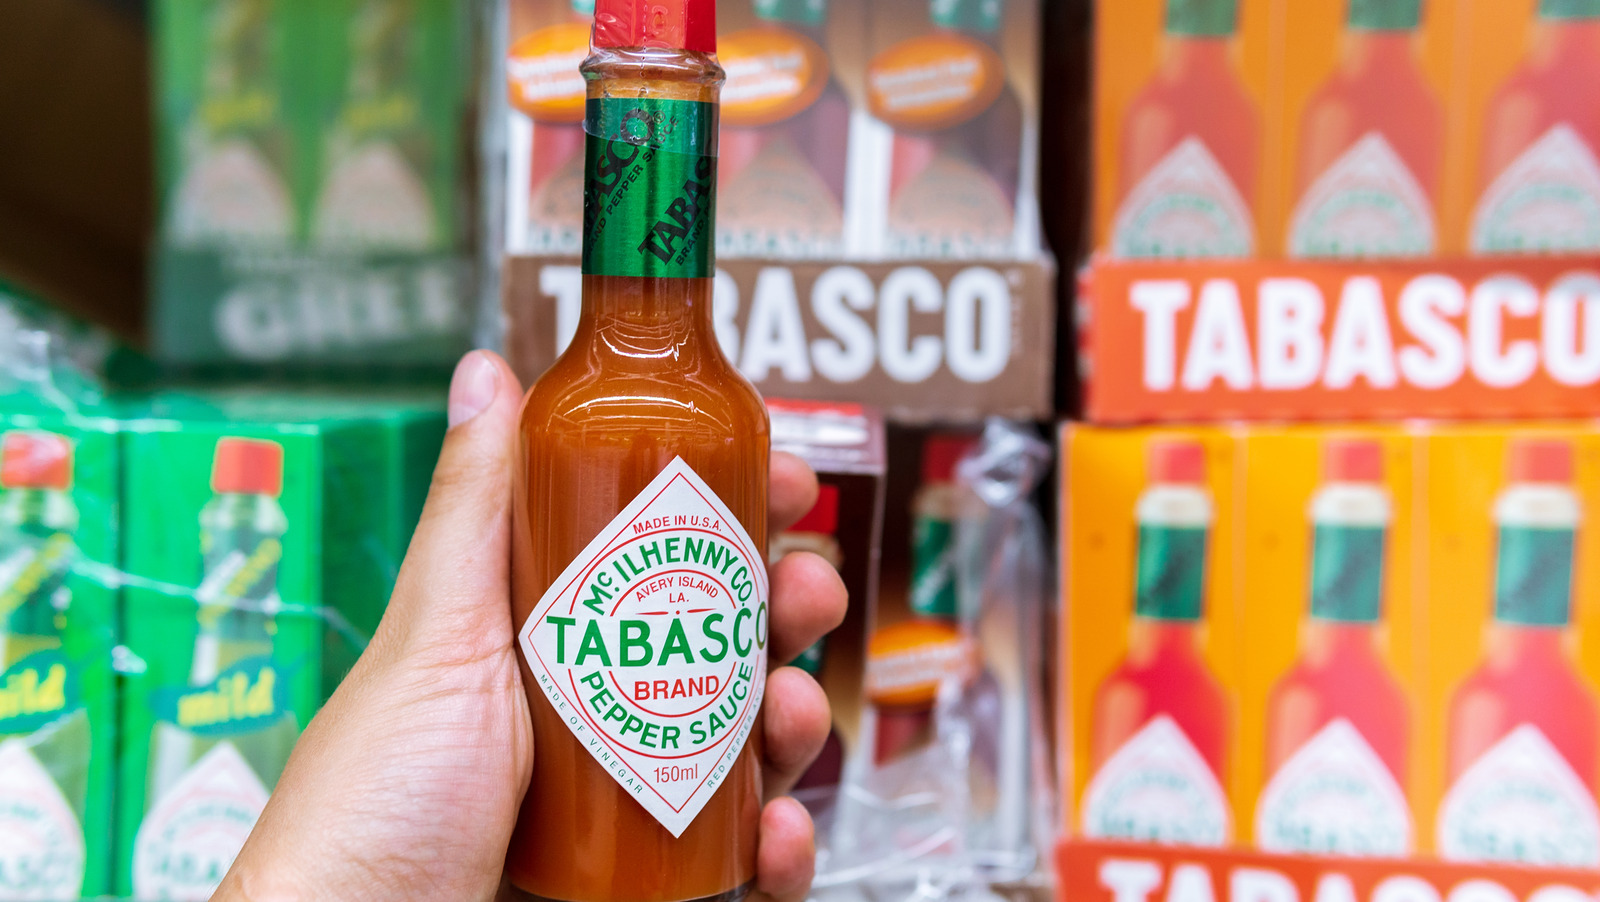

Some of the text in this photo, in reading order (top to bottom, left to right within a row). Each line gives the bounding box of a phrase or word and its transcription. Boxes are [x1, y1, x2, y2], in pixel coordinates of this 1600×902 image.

[606, 163, 643, 215] PEPPER
[642, 115, 679, 163] SAUCE
[675, 218, 705, 266] BRAND
[1128, 273, 1600, 392] TABASCO
[633, 515, 722, 534] MADE IN U.S.A.
[635, 576, 719, 602] AVERY ISLAND
[669, 592, 690, 603] LA.
[546, 601, 767, 667] TABASCO
[0, 663, 66, 720] ild
[580, 662, 754, 749] PEPPER SAUCE
[634, 675, 720, 701] BRAND
[540, 674, 643, 794] MADE OF VINEGAR
[707, 764, 726, 788] RED
[726, 715, 752, 760] PEPPER
[653, 763, 698, 783] 150ml
